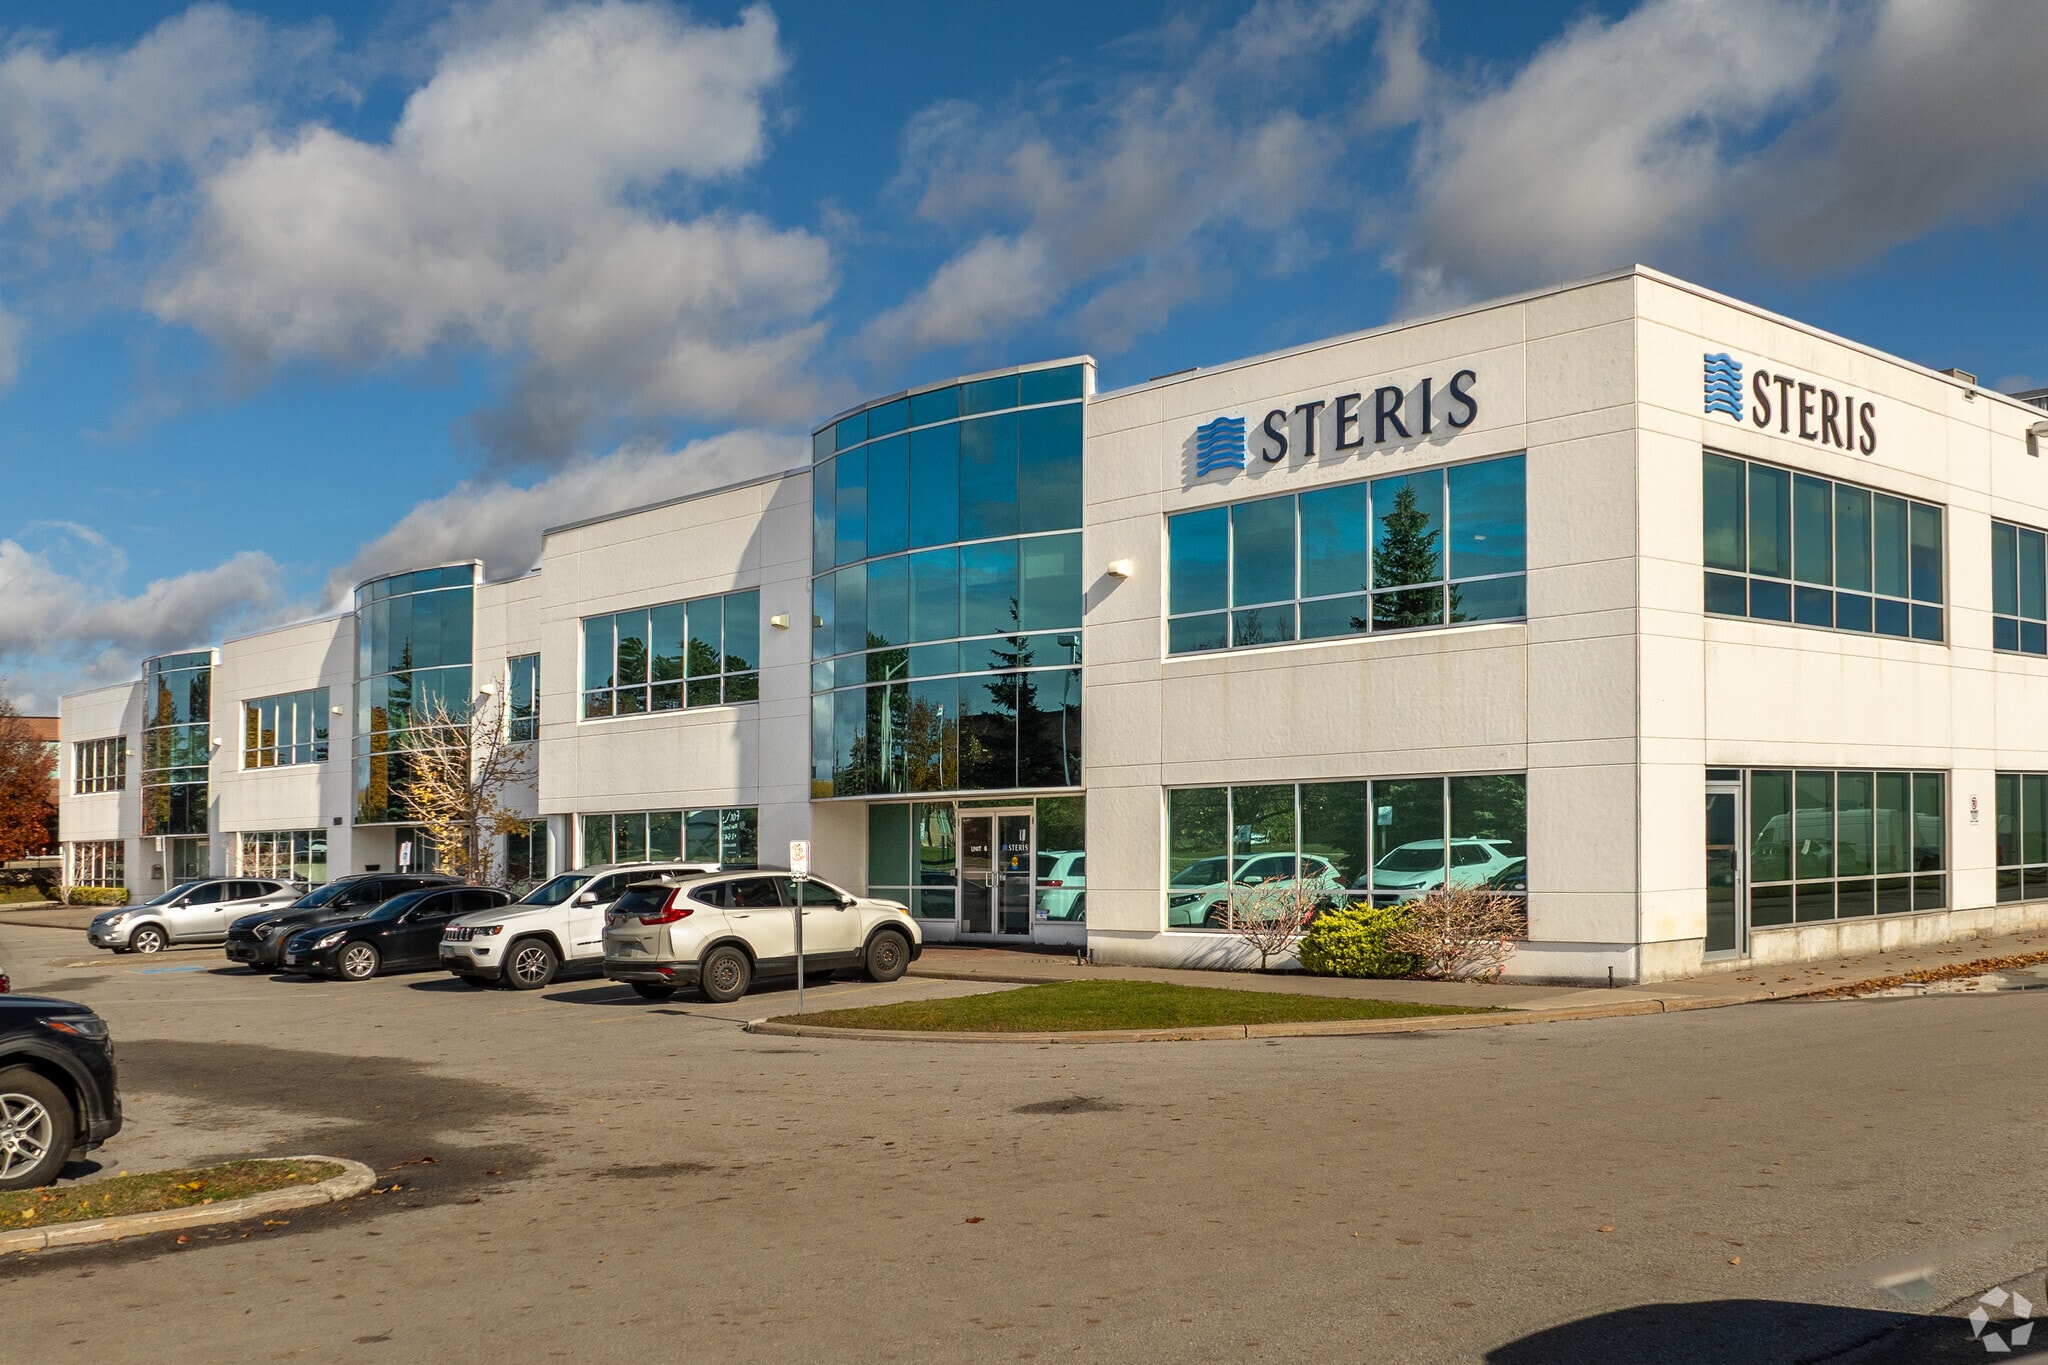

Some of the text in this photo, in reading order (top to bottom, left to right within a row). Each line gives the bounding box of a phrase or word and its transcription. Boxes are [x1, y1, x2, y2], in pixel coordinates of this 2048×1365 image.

[1262, 369, 1478, 463] STERIS
[1752, 369, 1876, 456] STERIS
[1008, 844, 1029, 852] STERIS
